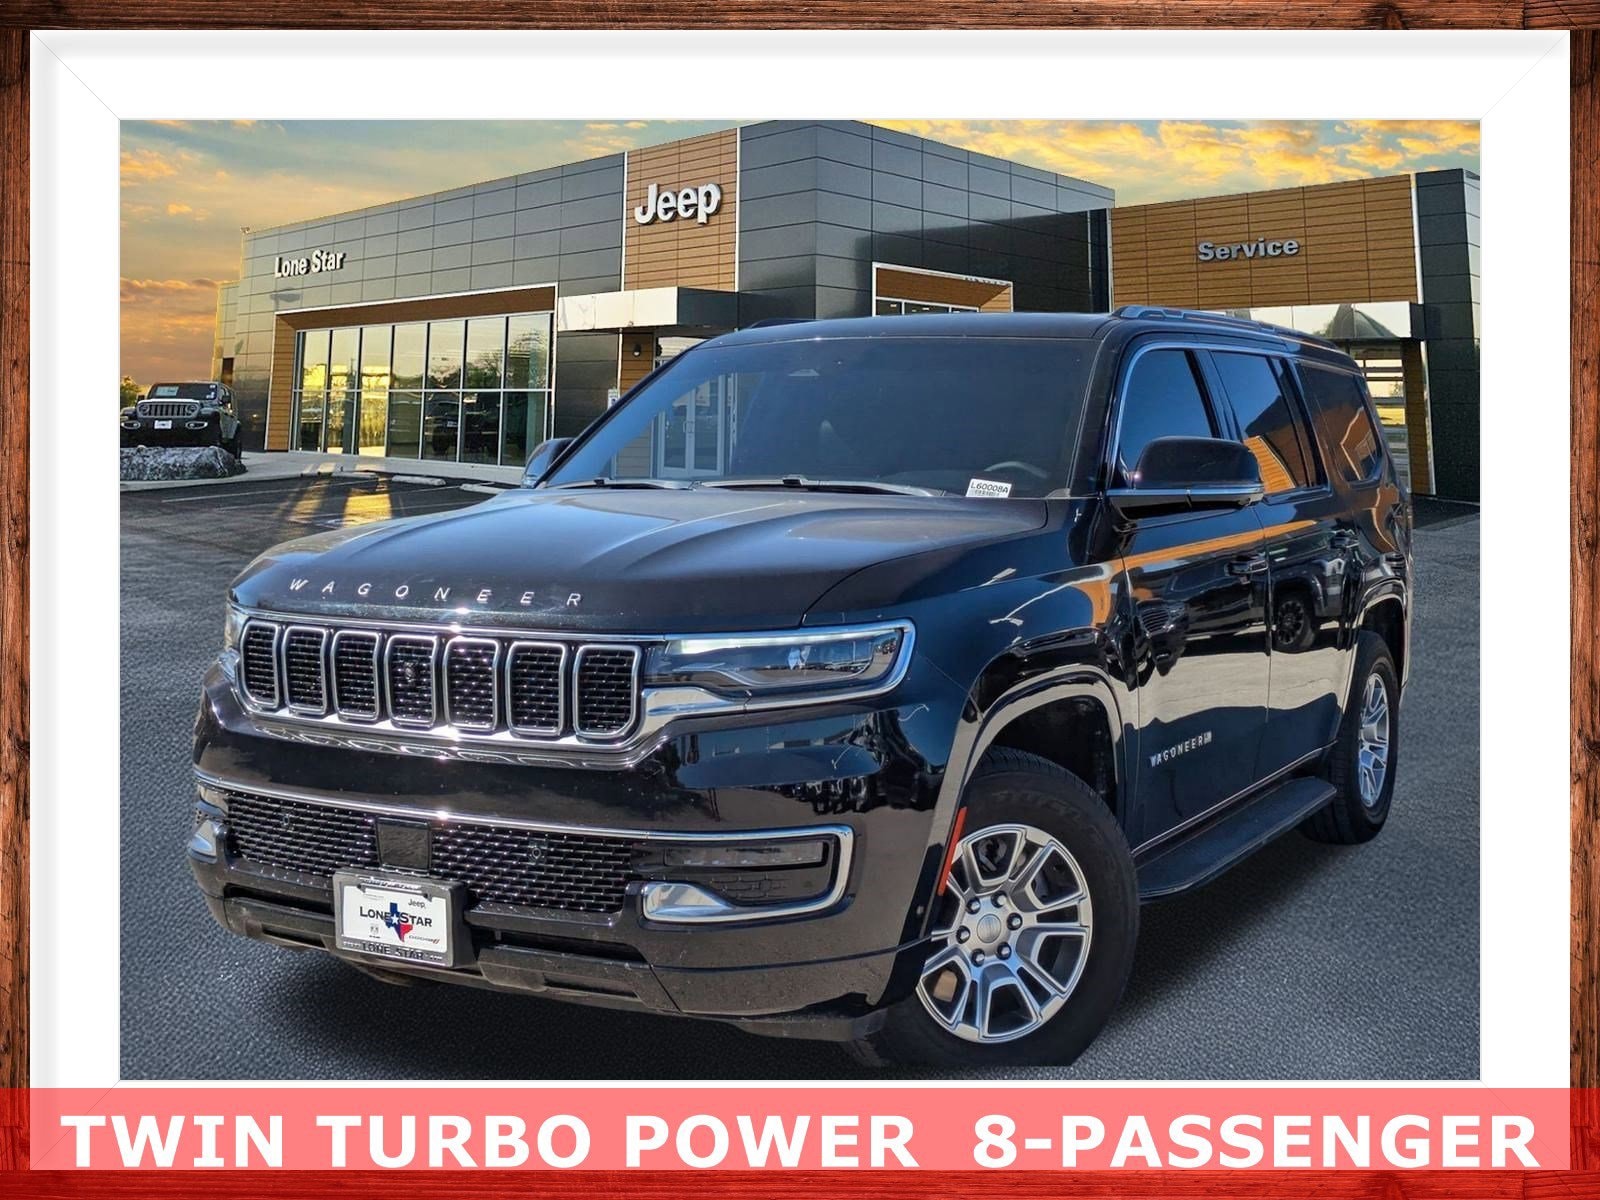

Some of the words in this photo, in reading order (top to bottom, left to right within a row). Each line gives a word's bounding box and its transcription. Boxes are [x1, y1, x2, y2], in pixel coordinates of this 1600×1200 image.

[634, 183, 722, 224] Jeep
[1198, 237, 1300, 261] Service
[274, 257, 311, 278] Lone
[311, 249, 346, 273] Star
[970, 482, 1009, 494] L60008A
[289, 578, 582, 607] WAGONEER
[1150, 735, 1204, 768] WAGONEER
[359, 906, 391, 922] LONE
[399, 912, 432, 927] STAR
[407, 899, 426, 909] Jeep
